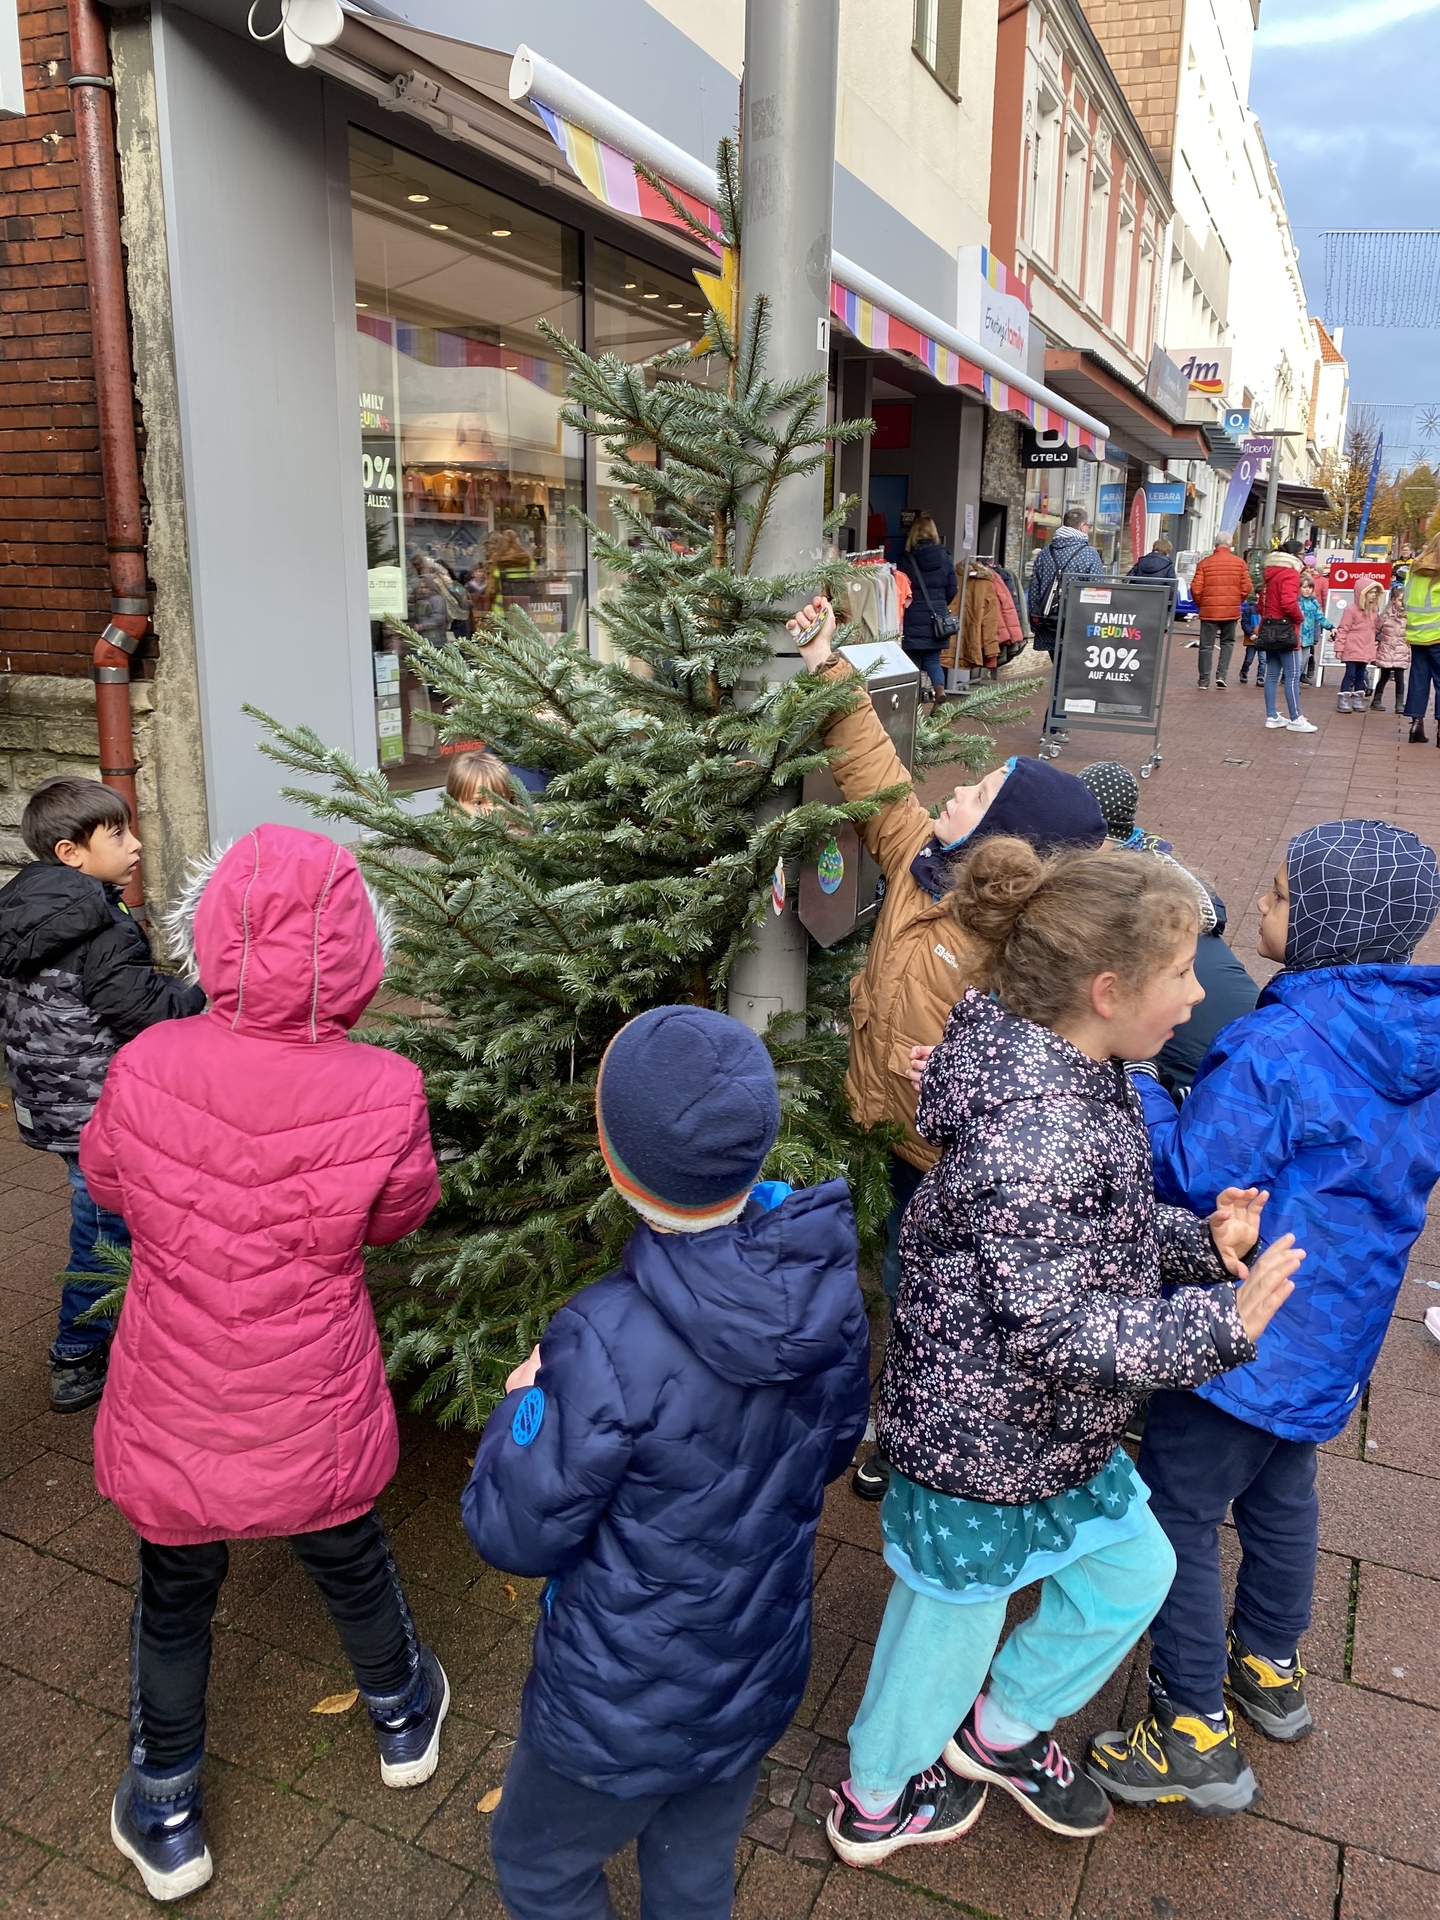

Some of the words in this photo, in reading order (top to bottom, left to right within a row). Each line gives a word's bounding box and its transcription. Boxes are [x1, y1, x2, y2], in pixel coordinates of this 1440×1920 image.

[821, 321, 826, 349] 1
[1180, 356, 1219, 380] dm
[359, 393, 384, 411] MILY
[360, 411, 390, 432] EUDAYS
[362, 453, 394, 490] 0%
[1148, 492, 1181, 501] LEBARA
[1349, 572, 1386, 580] vodafone
[1094, 611, 1137, 625] FAMILY
[1087, 625, 1142, 641] FREUDAYS
[1084, 645, 1140, 671] 30%
[1088, 670, 1105, 680] AUF
[440, 745, 454, 755] Von
